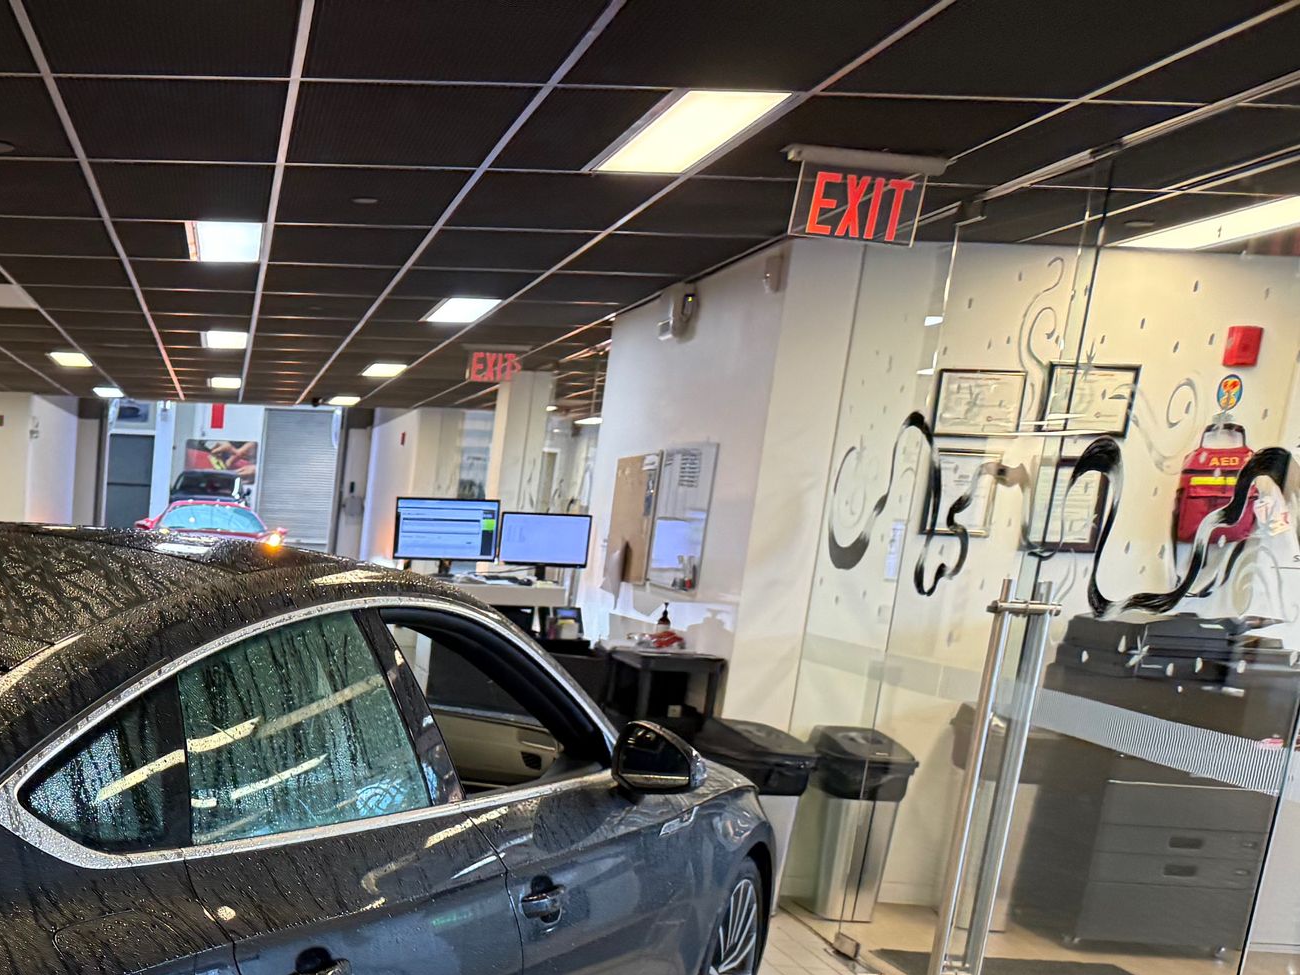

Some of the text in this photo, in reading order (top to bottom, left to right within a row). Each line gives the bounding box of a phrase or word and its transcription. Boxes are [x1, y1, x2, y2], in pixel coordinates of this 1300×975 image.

[805, 171, 916, 242] EXIT
[470, 352, 517, 382] EXIT
[1209, 456, 1240, 466] AED
